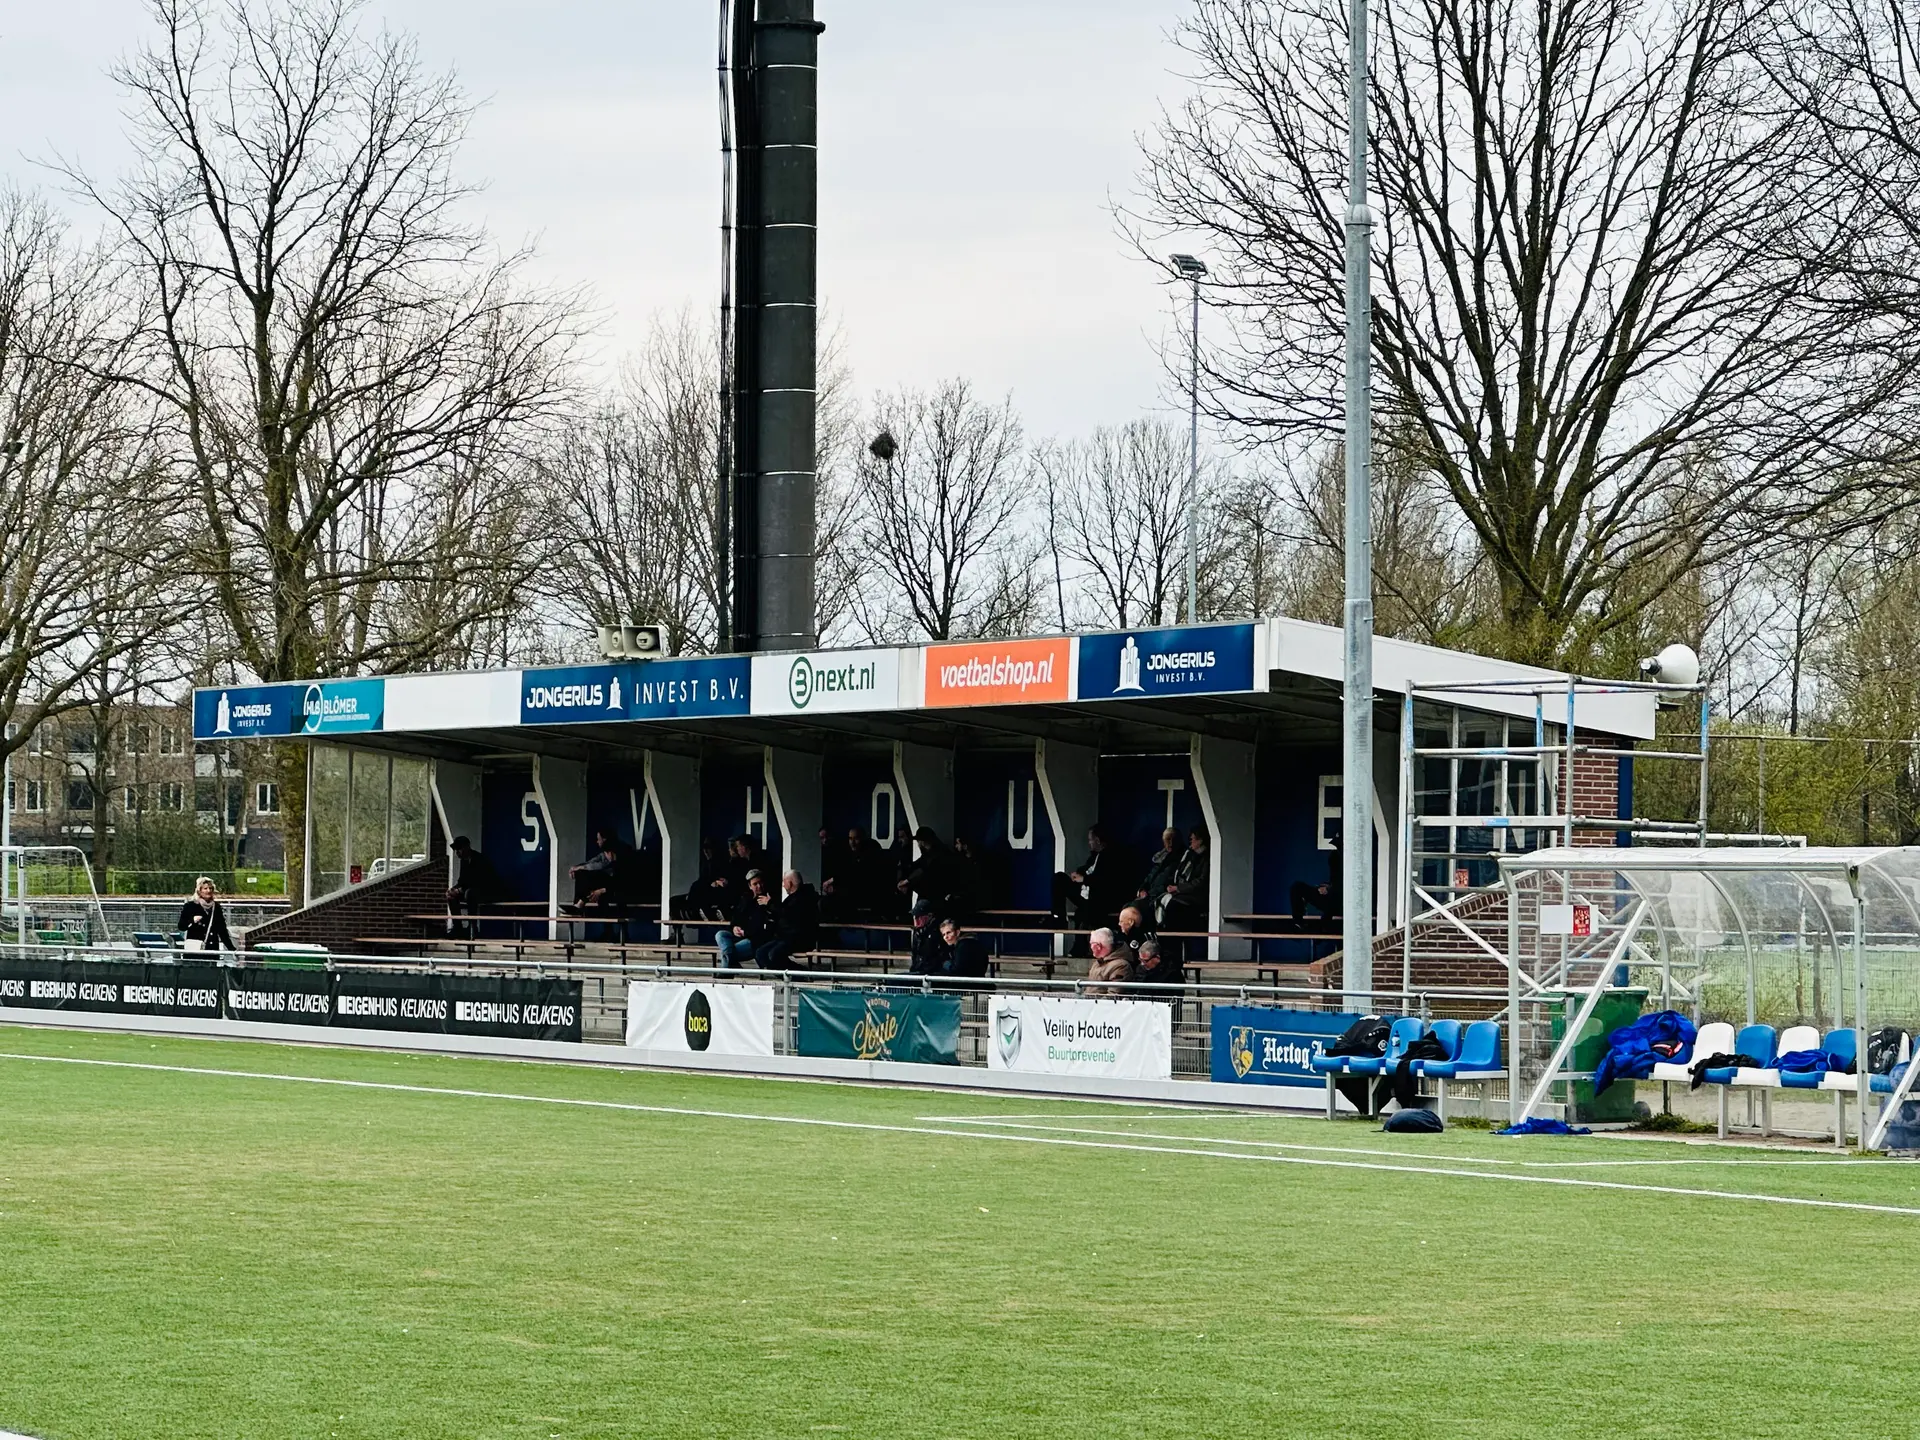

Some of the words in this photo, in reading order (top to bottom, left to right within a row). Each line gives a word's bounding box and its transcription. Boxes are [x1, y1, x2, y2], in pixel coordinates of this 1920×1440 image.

[940, 652, 1055, 692] voetbalshop.nl
[1146, 651, 1216, 671] JONGERIUS
[1155, 672, 1186, 684] INVEST
[1189, 671, 1206, 682] B.V.
[526, 684, 603, 709] JONGERIUS
[635, 679, 699, 705] INVEST
[710, 677, 744, 701] B.V.
[232, 703, 272, 718] JONGERIUS
[305, 700, 322, 716] HLB
[323, 695, 358, 715] BLÖMER
[236, 719, 255, 728] INVEST
[38, 980, 77, 1000] EIGENHUIS
[78, 983, 118, 1003] KEUKENS
[129, 985, 175, 1006] EIGENHUIS
[176, 988, 218, 1008] KEUKENS
[236, 990, 285, 1012] EIGENHUIS
[287, 992, 330, 1014] KEUKENS
[346, 995, 398, 1017] EIGENHUIS
[400, 997, 448, 1021] KEUKENS
[464, 1001, 520, 1025] EIGENHUIS
[522, 1004, 575, 1027] KEUKENS
[688, 1010, 709, 1033] boca
[1043, 1017, 1075, 1043] Veilig
[1077, 1020, 1122, 1040] Houten
[1047, 1045, 1116, 1064] Buurtpreventie
[1262, 1036, 1311, 1070] Hertog
